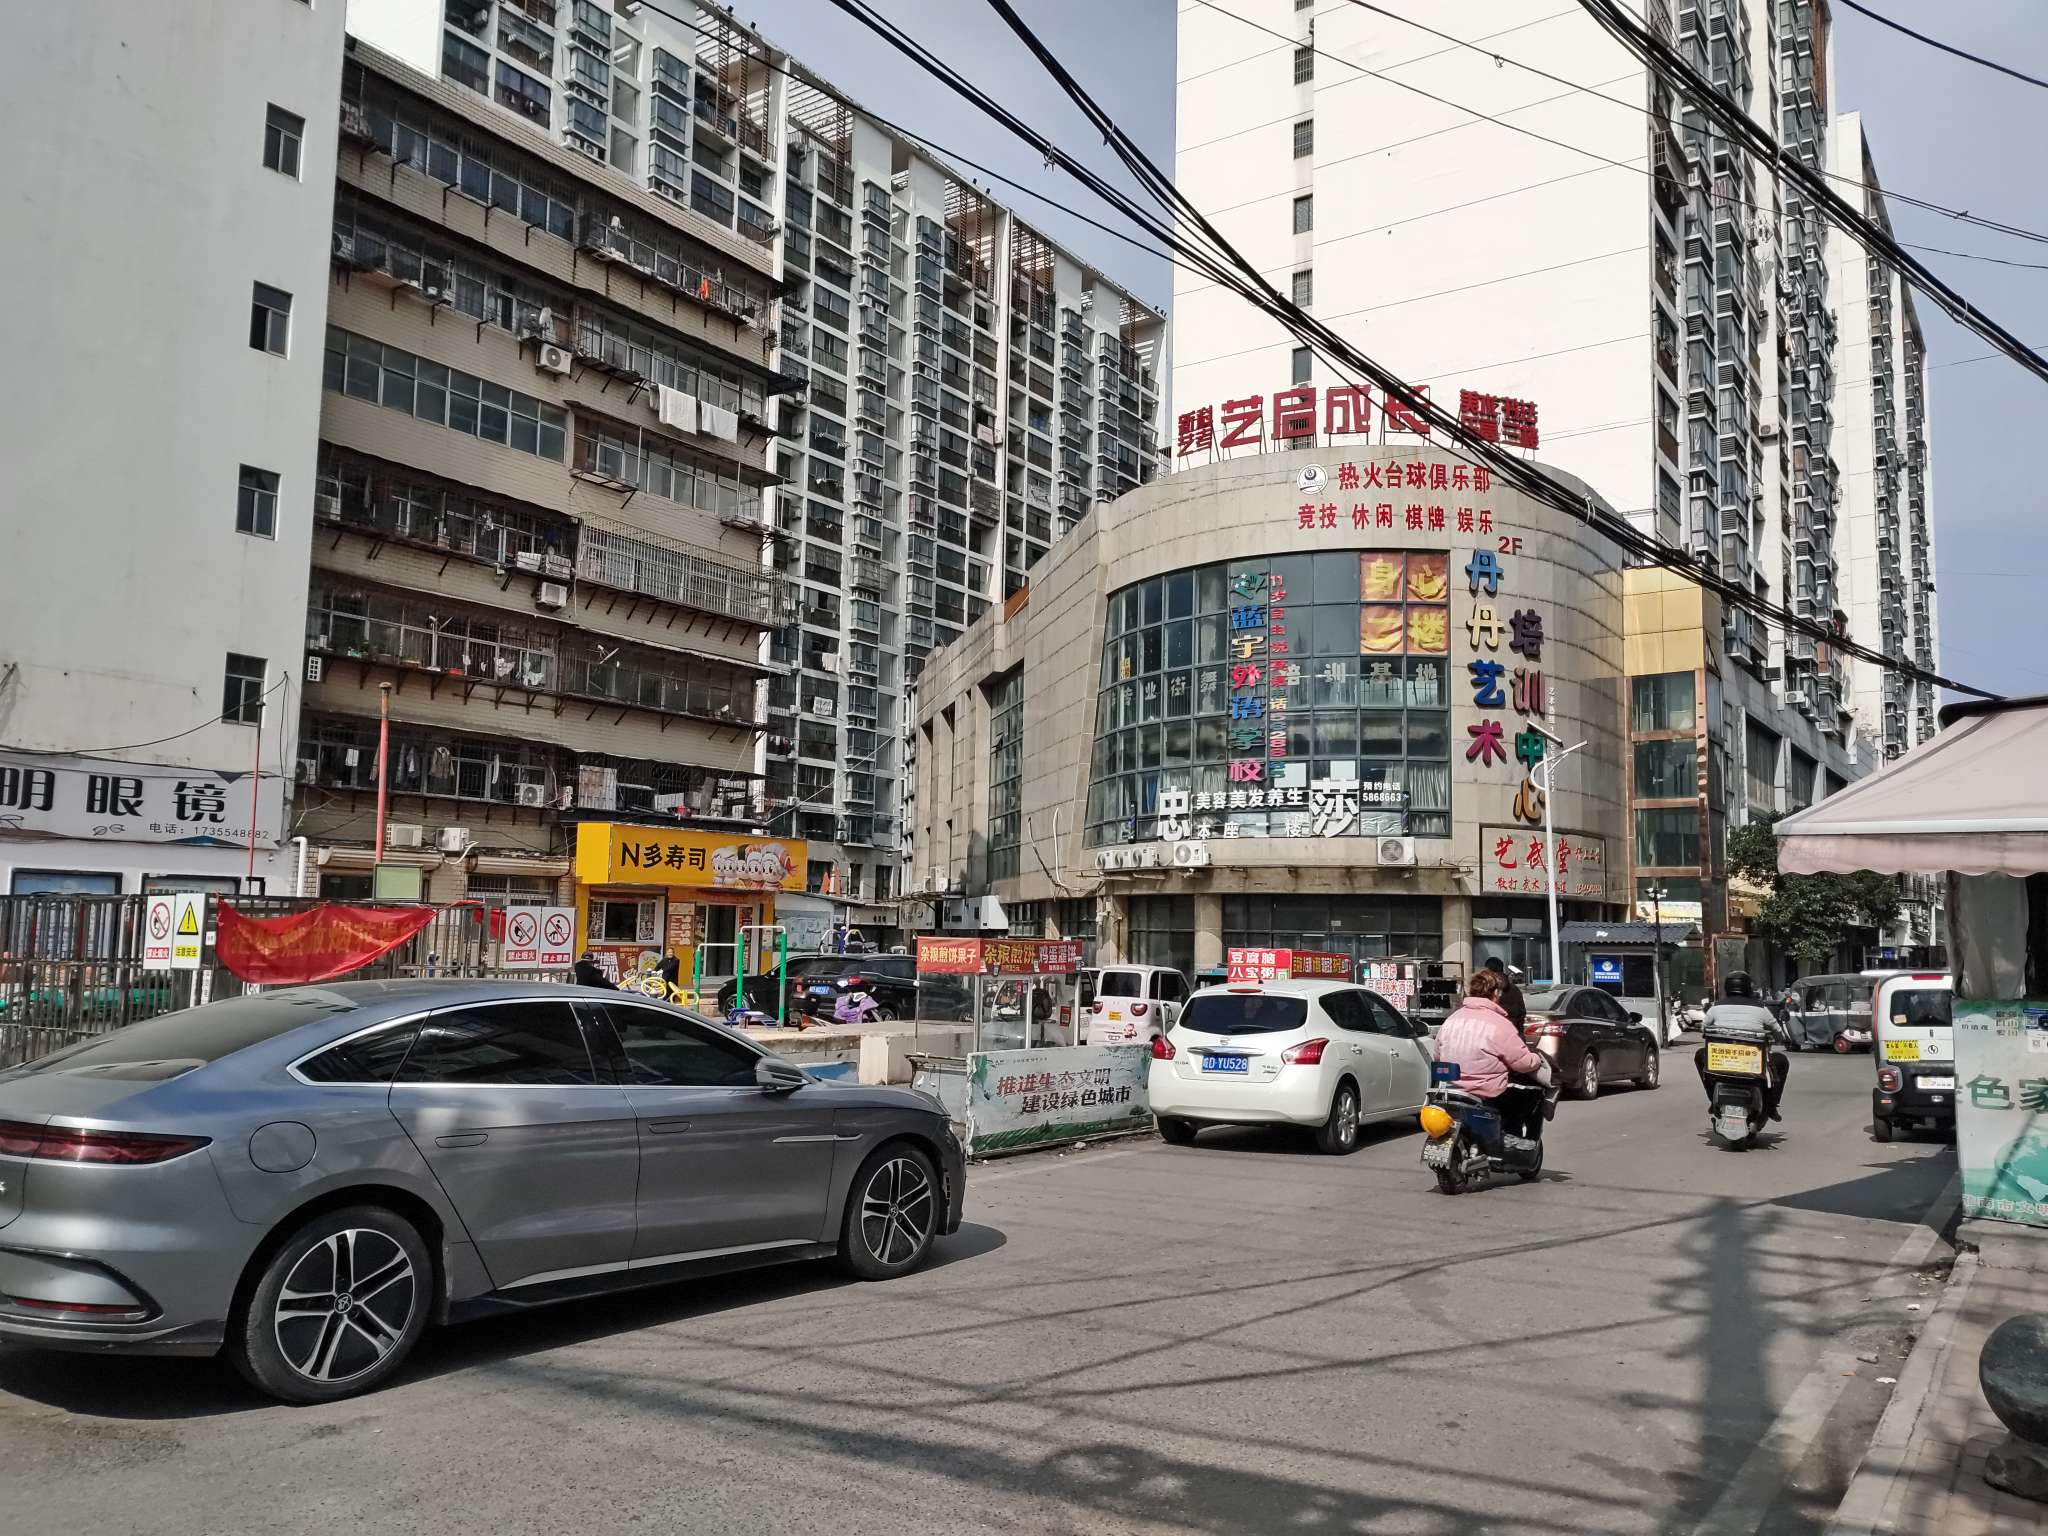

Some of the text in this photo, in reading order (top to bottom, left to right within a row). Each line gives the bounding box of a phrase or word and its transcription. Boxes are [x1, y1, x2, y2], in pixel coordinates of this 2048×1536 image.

[1338, 460, 1491, 494] 热火台球俱乐部
[1298, 503, 1493, 534] 竞技 休闲 棋牌 娱乐
[1498, 537, 1522, 554] 2F
[1465, 549, 1506, 767] 丹丹艺术
[1509, 608, 1546, 822] 培训中心
[1362, 792, 1402, 803] 5868663
[1363, 781, 1401, 791] 预约电话
[1196, 789, 1304, 810] 美容美发养生
[621, 843, 706, 871] N多寿司
[921, 945, 976, 964] 杂粮煎饼果子
[985, 944, 1035, 965] 杂粮煎饼
[1231, 952, 1276, 965] 豆腐脑
[1231, 967, 1275, 979] 八宝粥
[996, 1068, 1111, 1097] 推进生态文明
[1022, 1086, 1131, 1114] 建设绿色城市
